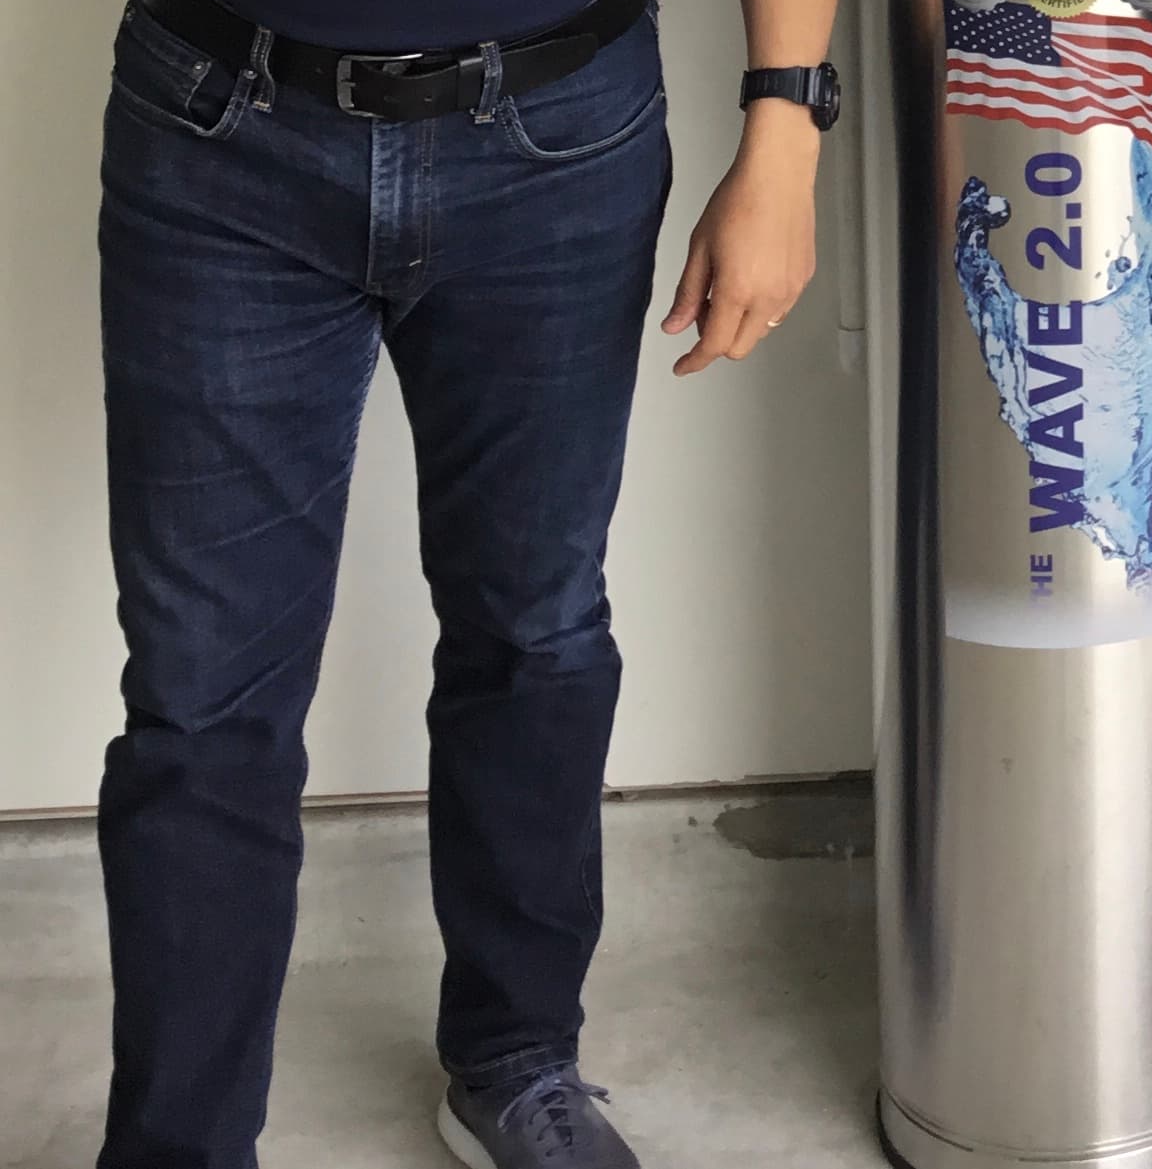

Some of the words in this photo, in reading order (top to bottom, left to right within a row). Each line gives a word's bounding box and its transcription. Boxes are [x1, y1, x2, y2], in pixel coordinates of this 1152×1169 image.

[1024, 152, 1083, 271] 2.0
[1026, 300, 1084, 533] WAVE
[1030, 554, 1053, 611] HE
